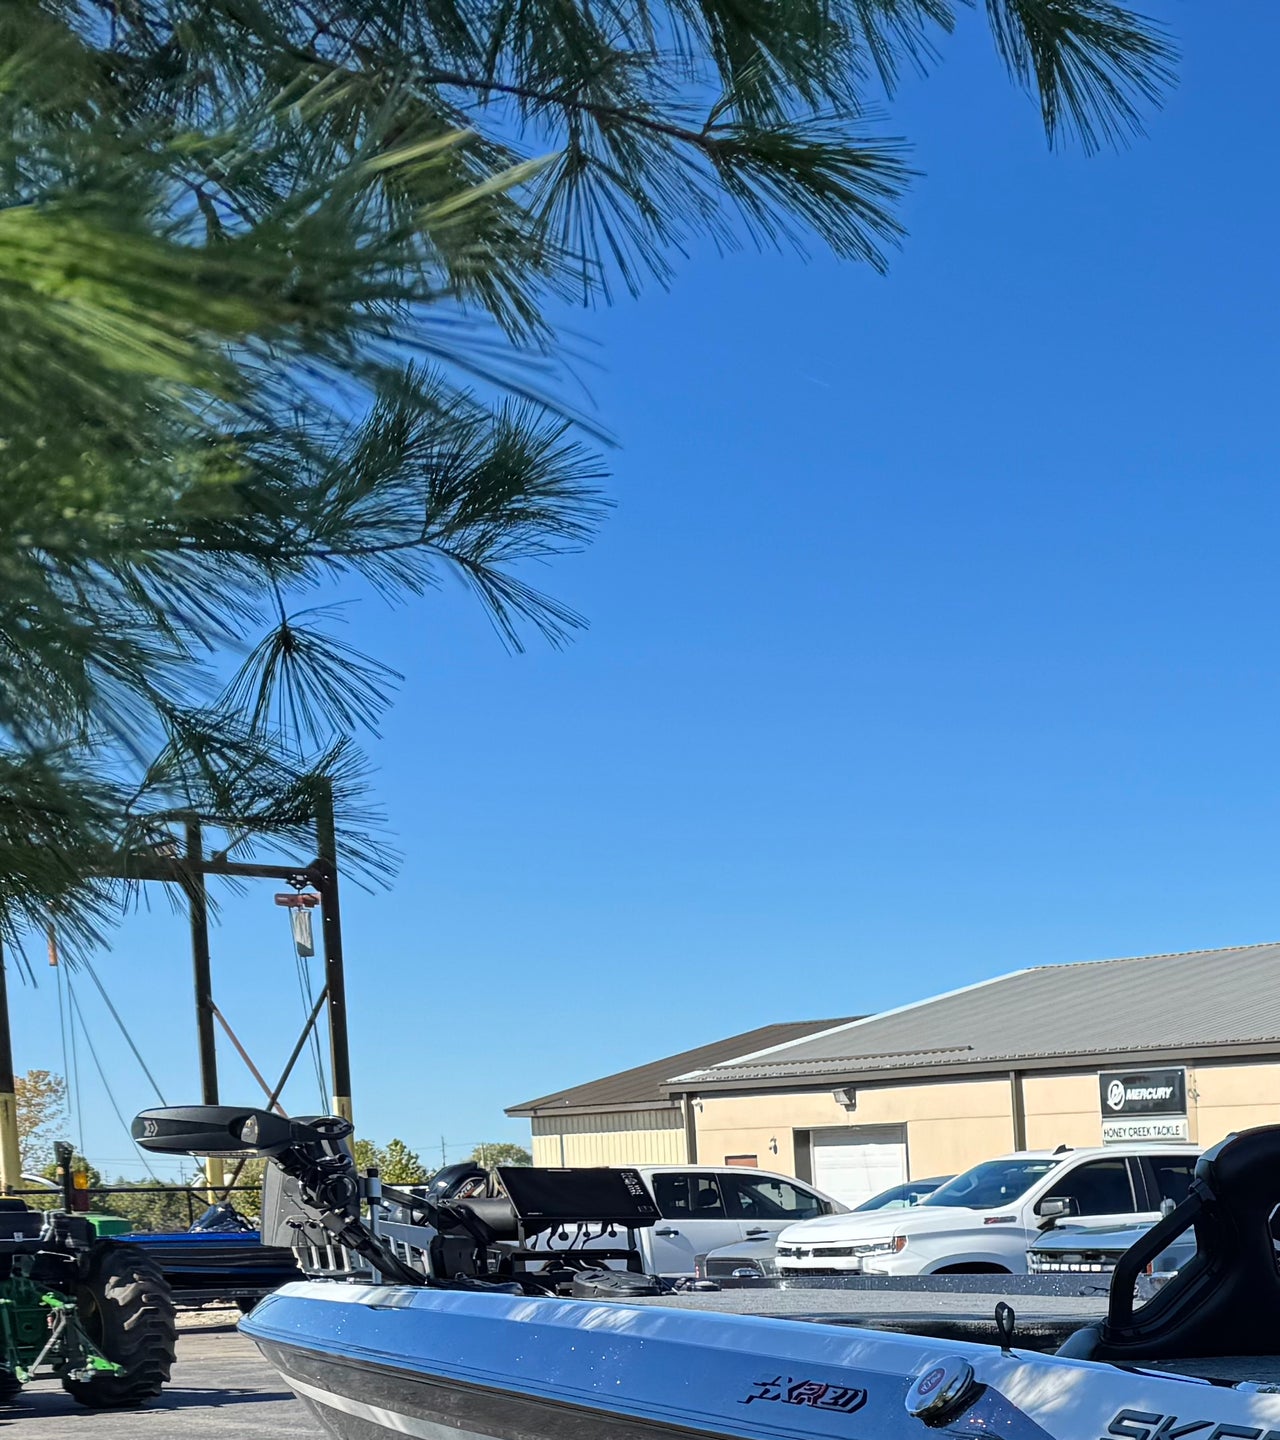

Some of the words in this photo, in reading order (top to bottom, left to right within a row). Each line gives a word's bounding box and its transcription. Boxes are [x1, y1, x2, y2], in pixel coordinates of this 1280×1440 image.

[1125, 1086, 1173, 1101] MERCURY
[1104, 1127, 1126, 1138] HONEY
[1128, 1126, 1151, 1138] CREEK
[1153, 1125, 1180, 1136] TACKLE
